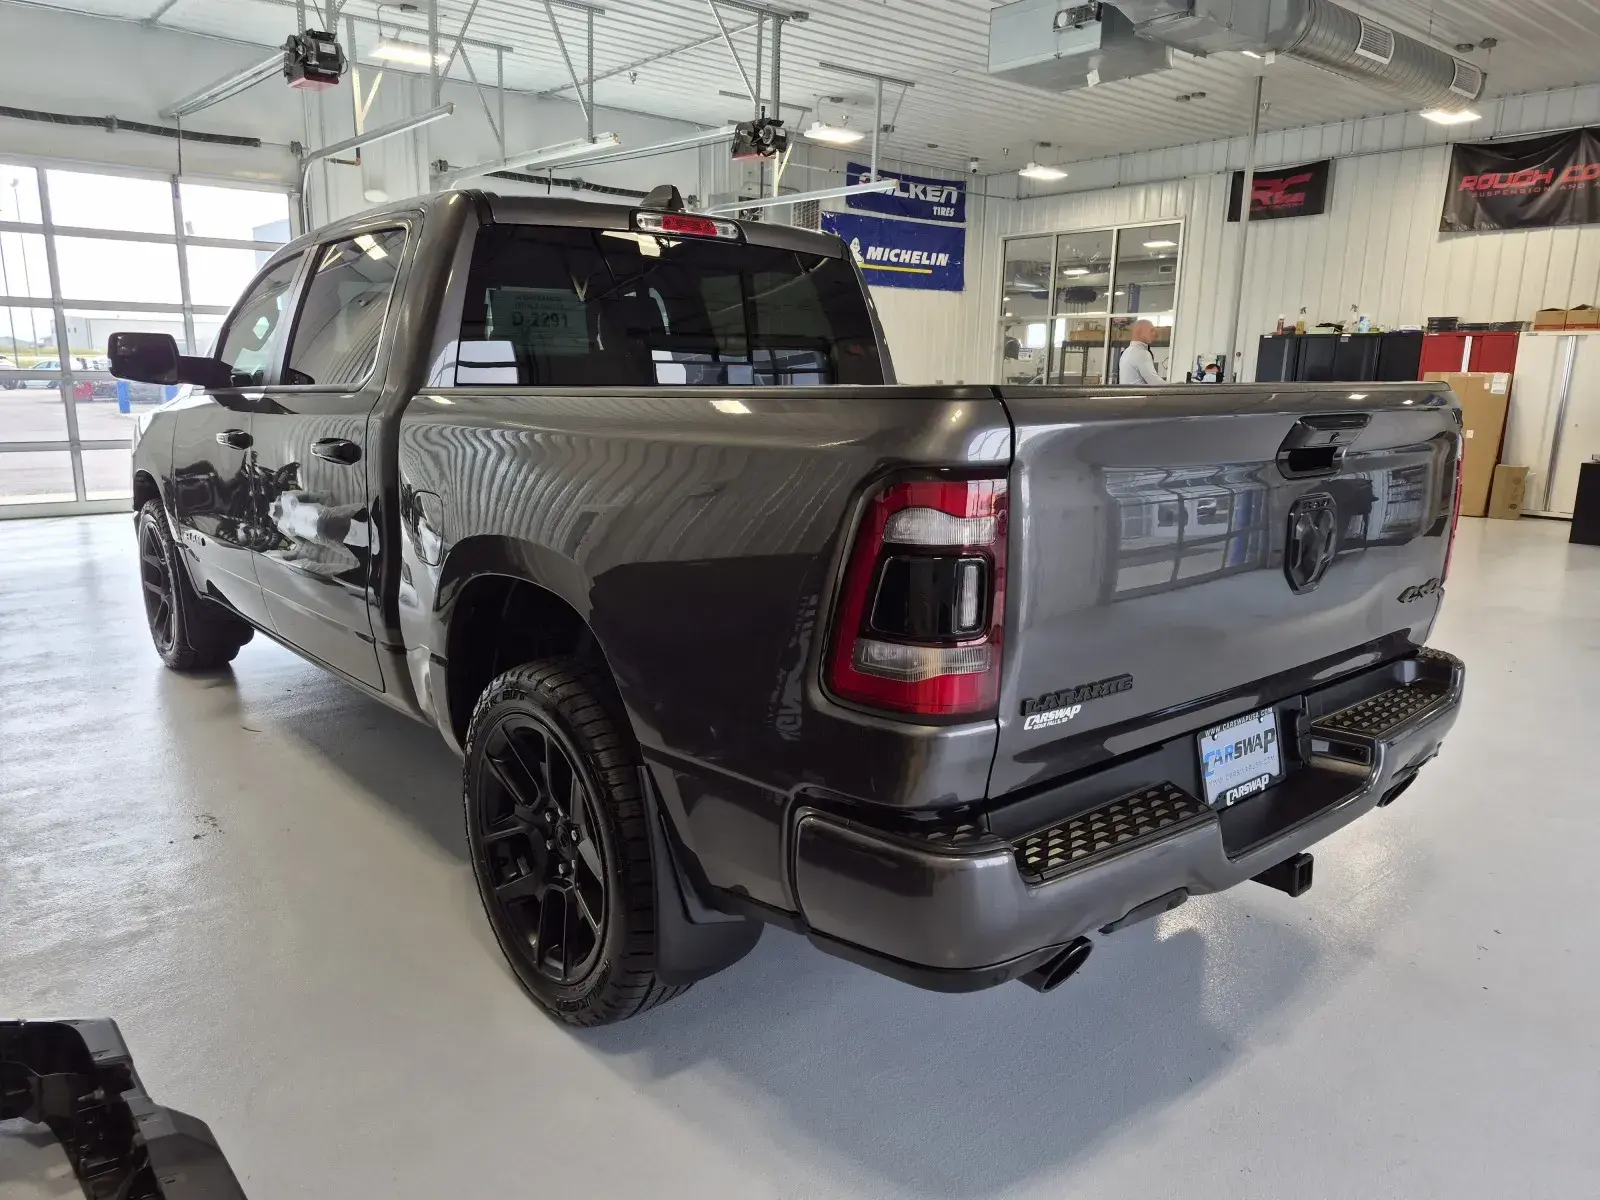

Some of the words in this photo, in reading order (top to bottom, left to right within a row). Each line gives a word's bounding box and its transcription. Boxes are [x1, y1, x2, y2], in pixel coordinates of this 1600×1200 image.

[1458, 167, 1554, 191] ROUGH
[1471, 186, 1551, 198] SUSPENSION
[1559, 182, 1586, 191] AND
[932, 206, 955, 217] TIRES
[866, 246, 950, 267] MICHELIN
[1019, 673, 1134, 716] LARAMIE
[1023, 704, 1082, 730] CARSWAP
[1203, 727, 1276, 777] CARSWAP
[1226, 774, 1269, 806] CARSWAP
